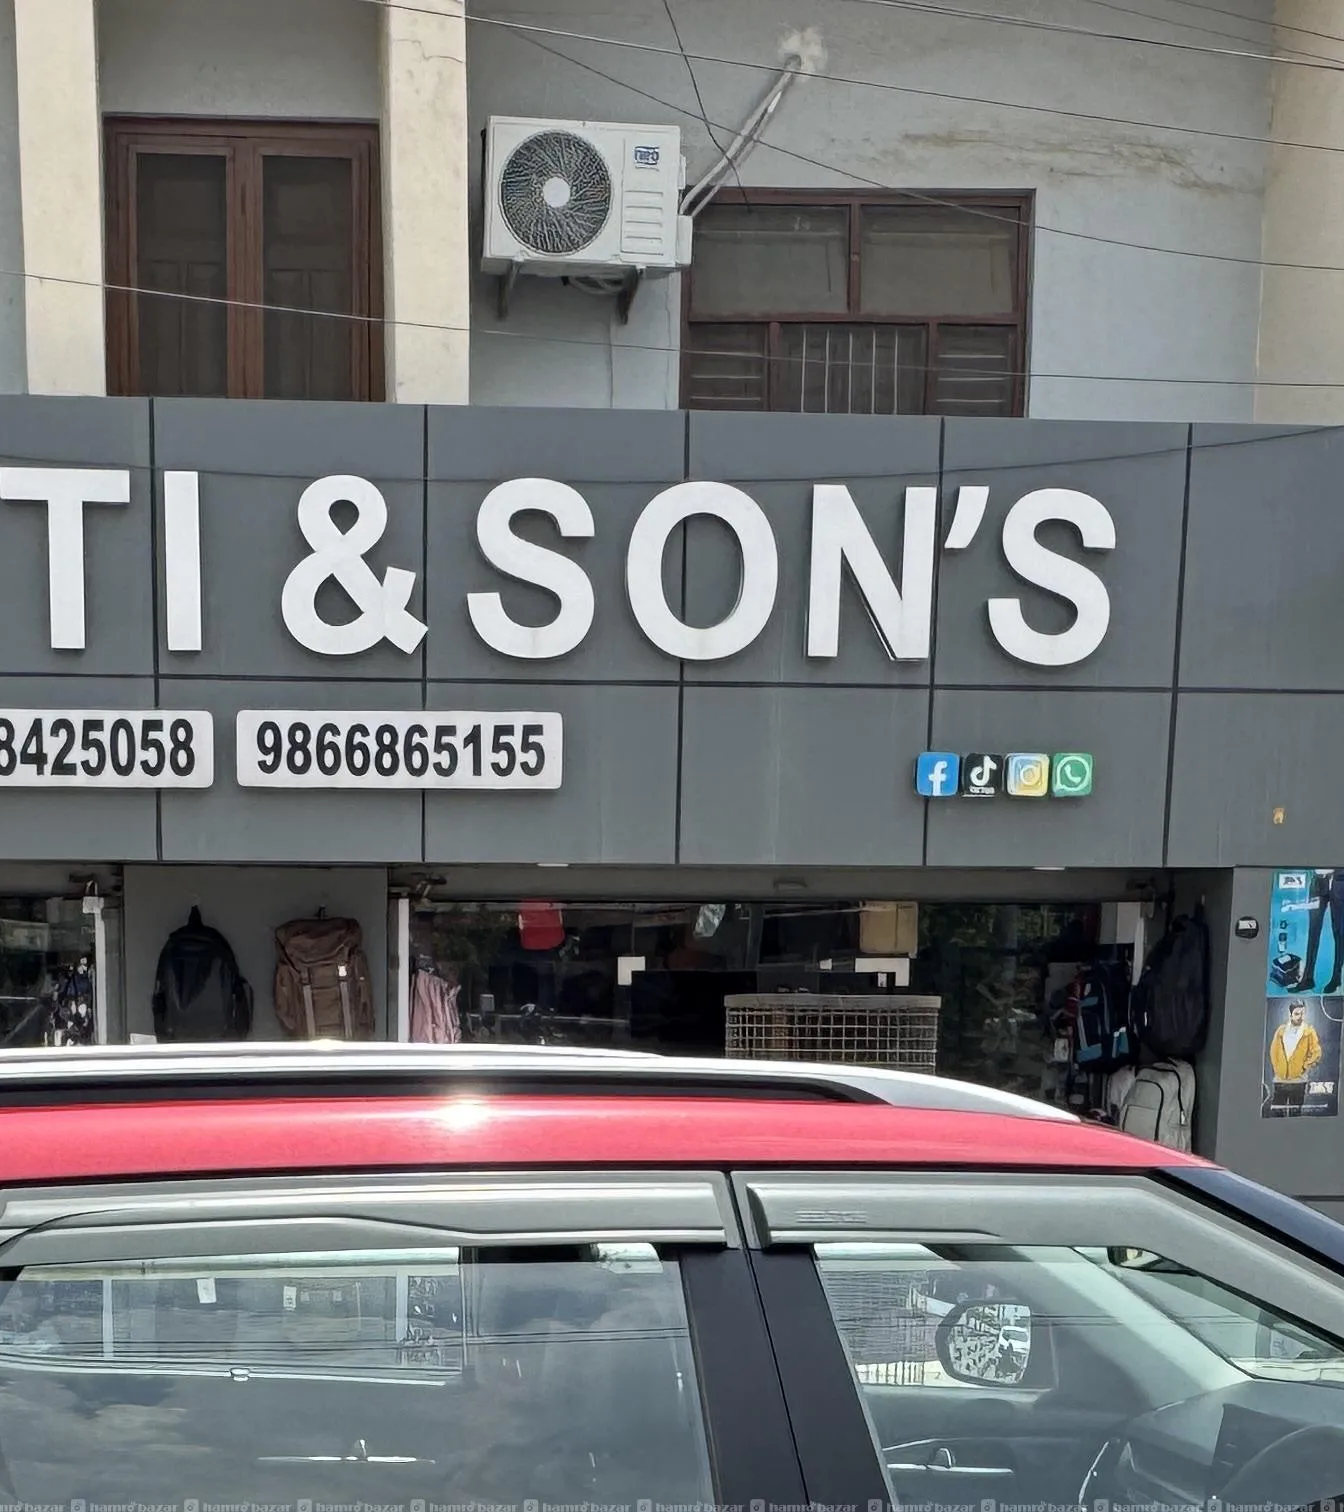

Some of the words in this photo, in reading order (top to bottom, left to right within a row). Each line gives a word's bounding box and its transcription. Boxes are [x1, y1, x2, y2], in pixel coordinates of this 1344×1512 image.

[282, 475, 428, 655] &
[467, 478, 1116, 665] SON'S
[257, 720, 545, 778] 9866865155
